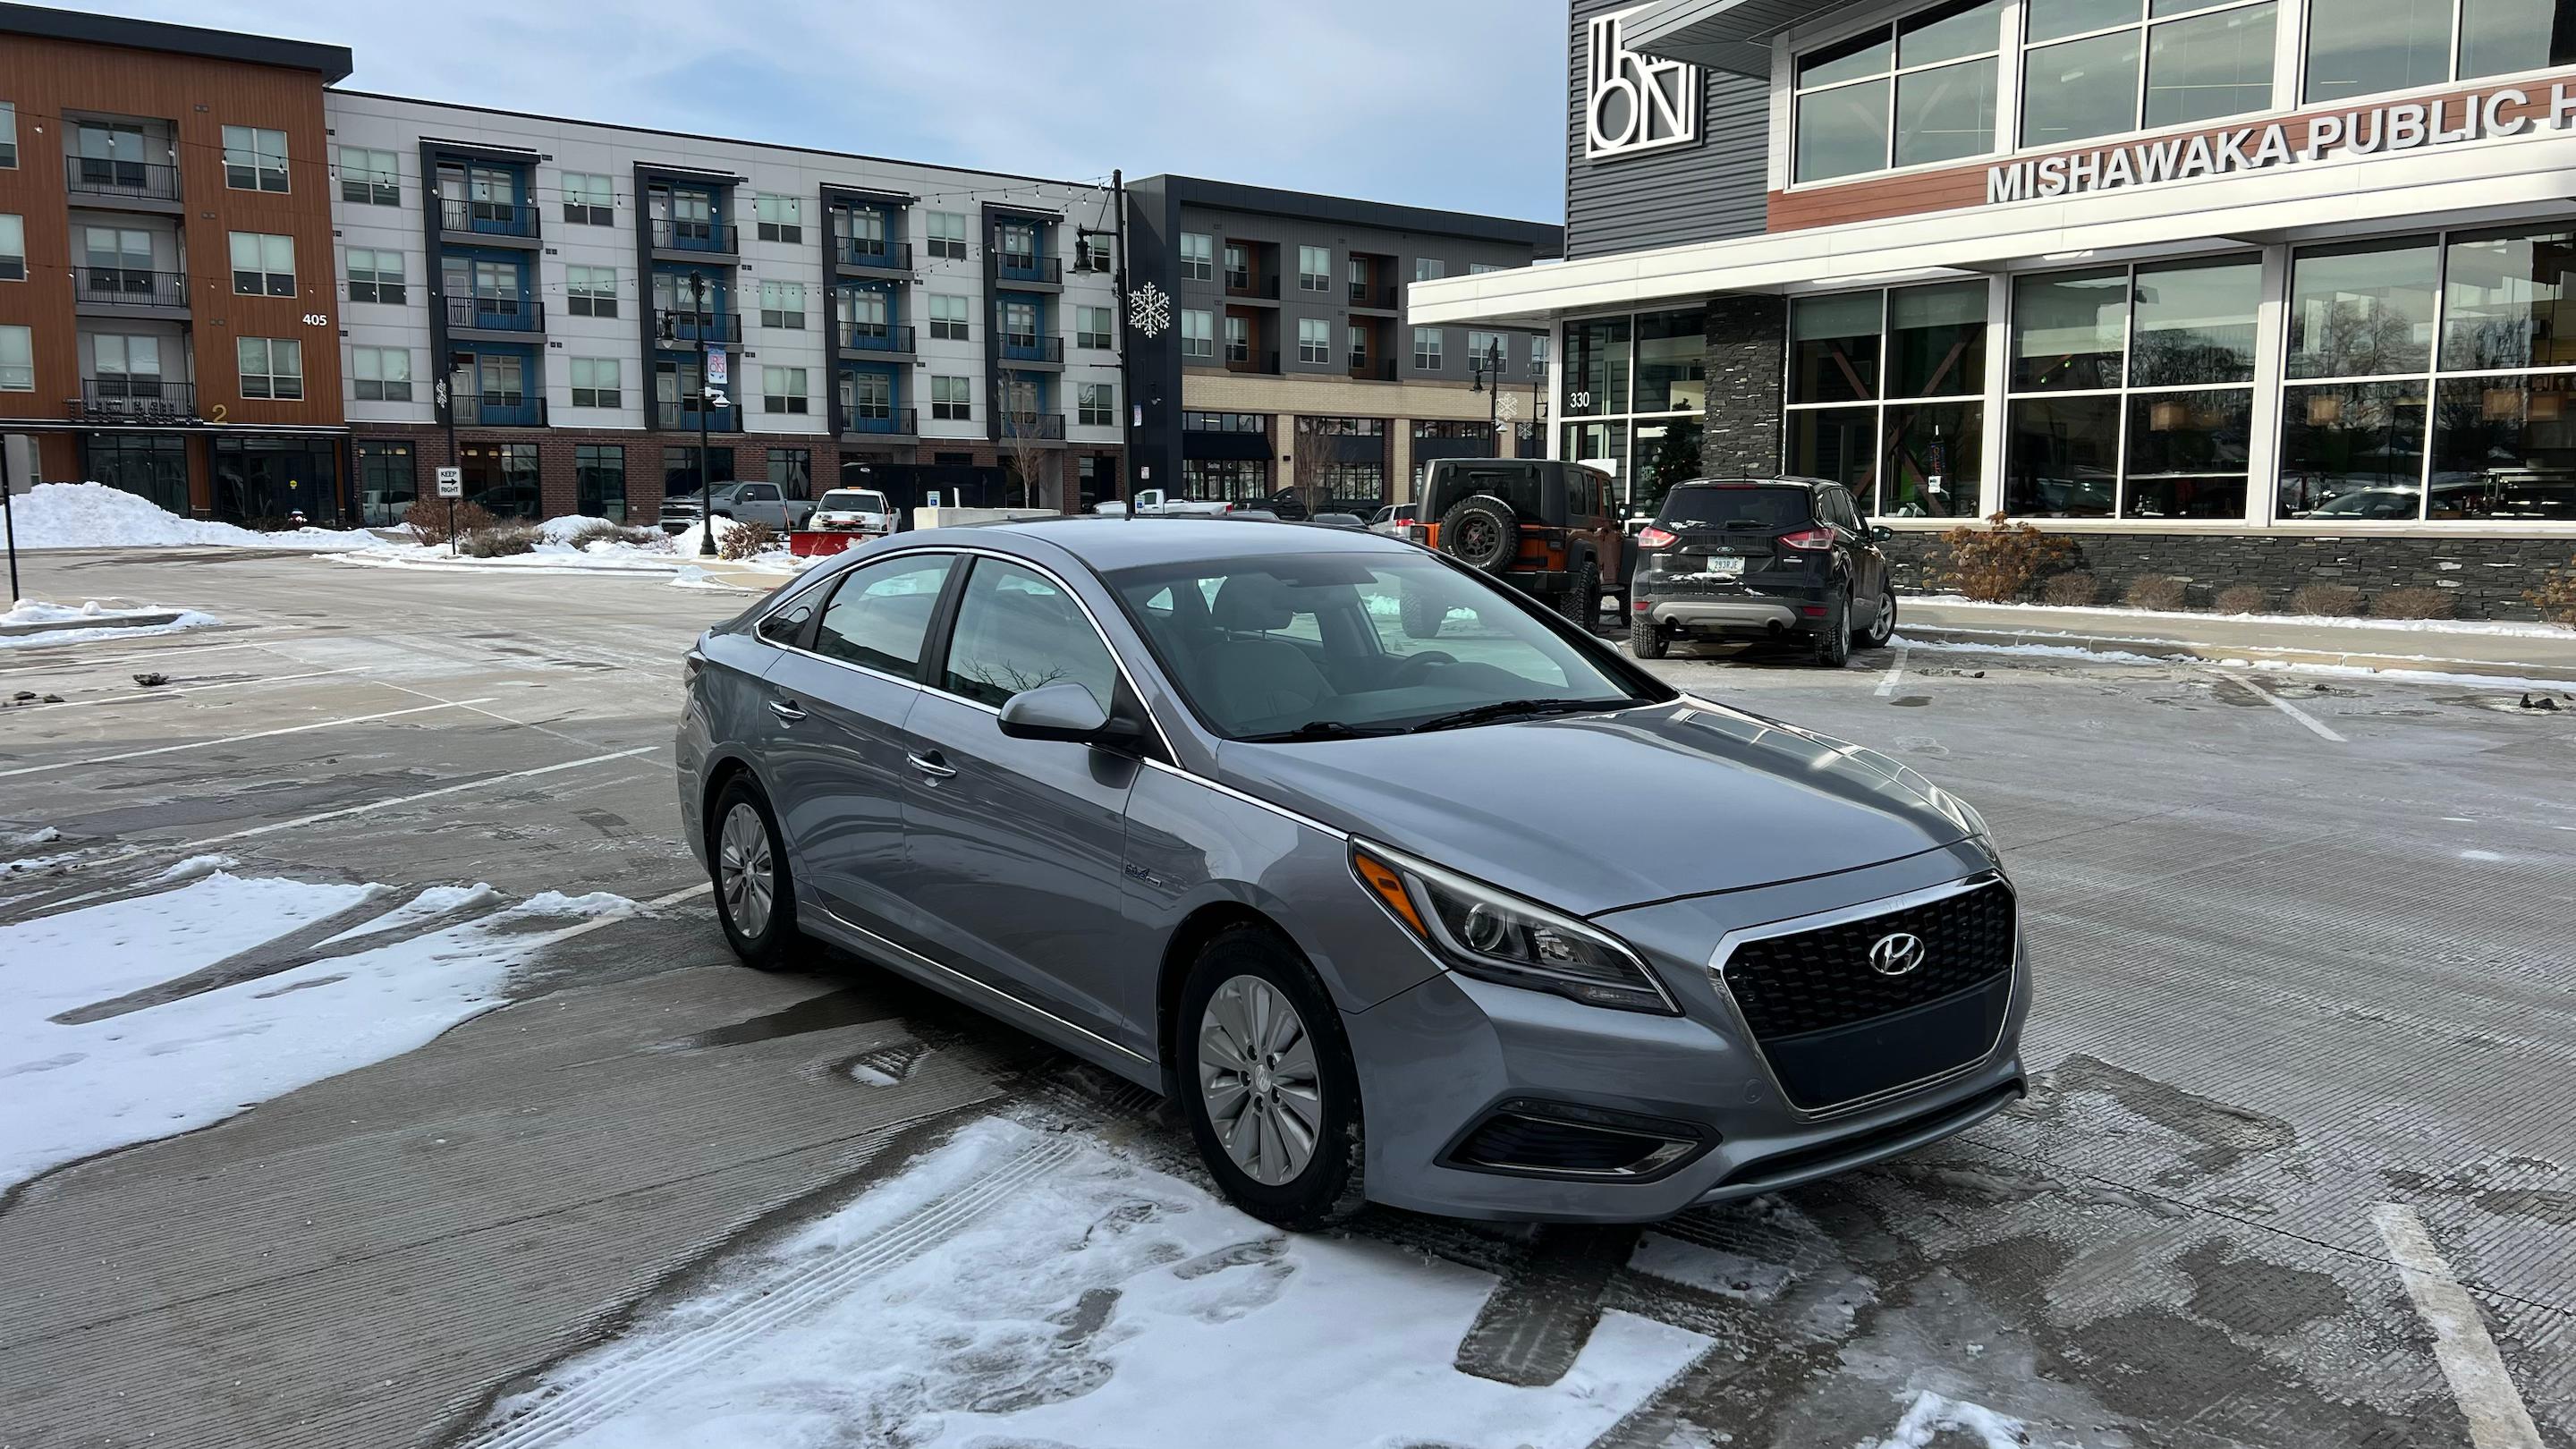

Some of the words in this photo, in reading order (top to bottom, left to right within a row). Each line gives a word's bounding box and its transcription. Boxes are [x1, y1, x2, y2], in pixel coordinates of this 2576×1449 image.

[1987, 123, 2296, 204] MISHAWAKA
[2308, 89, 2531, 160] PUBLIC
[302, 314, 327, 326] 405
[1570, 392, 1589, 408] 330
[212, 404, 227, 425] 2
